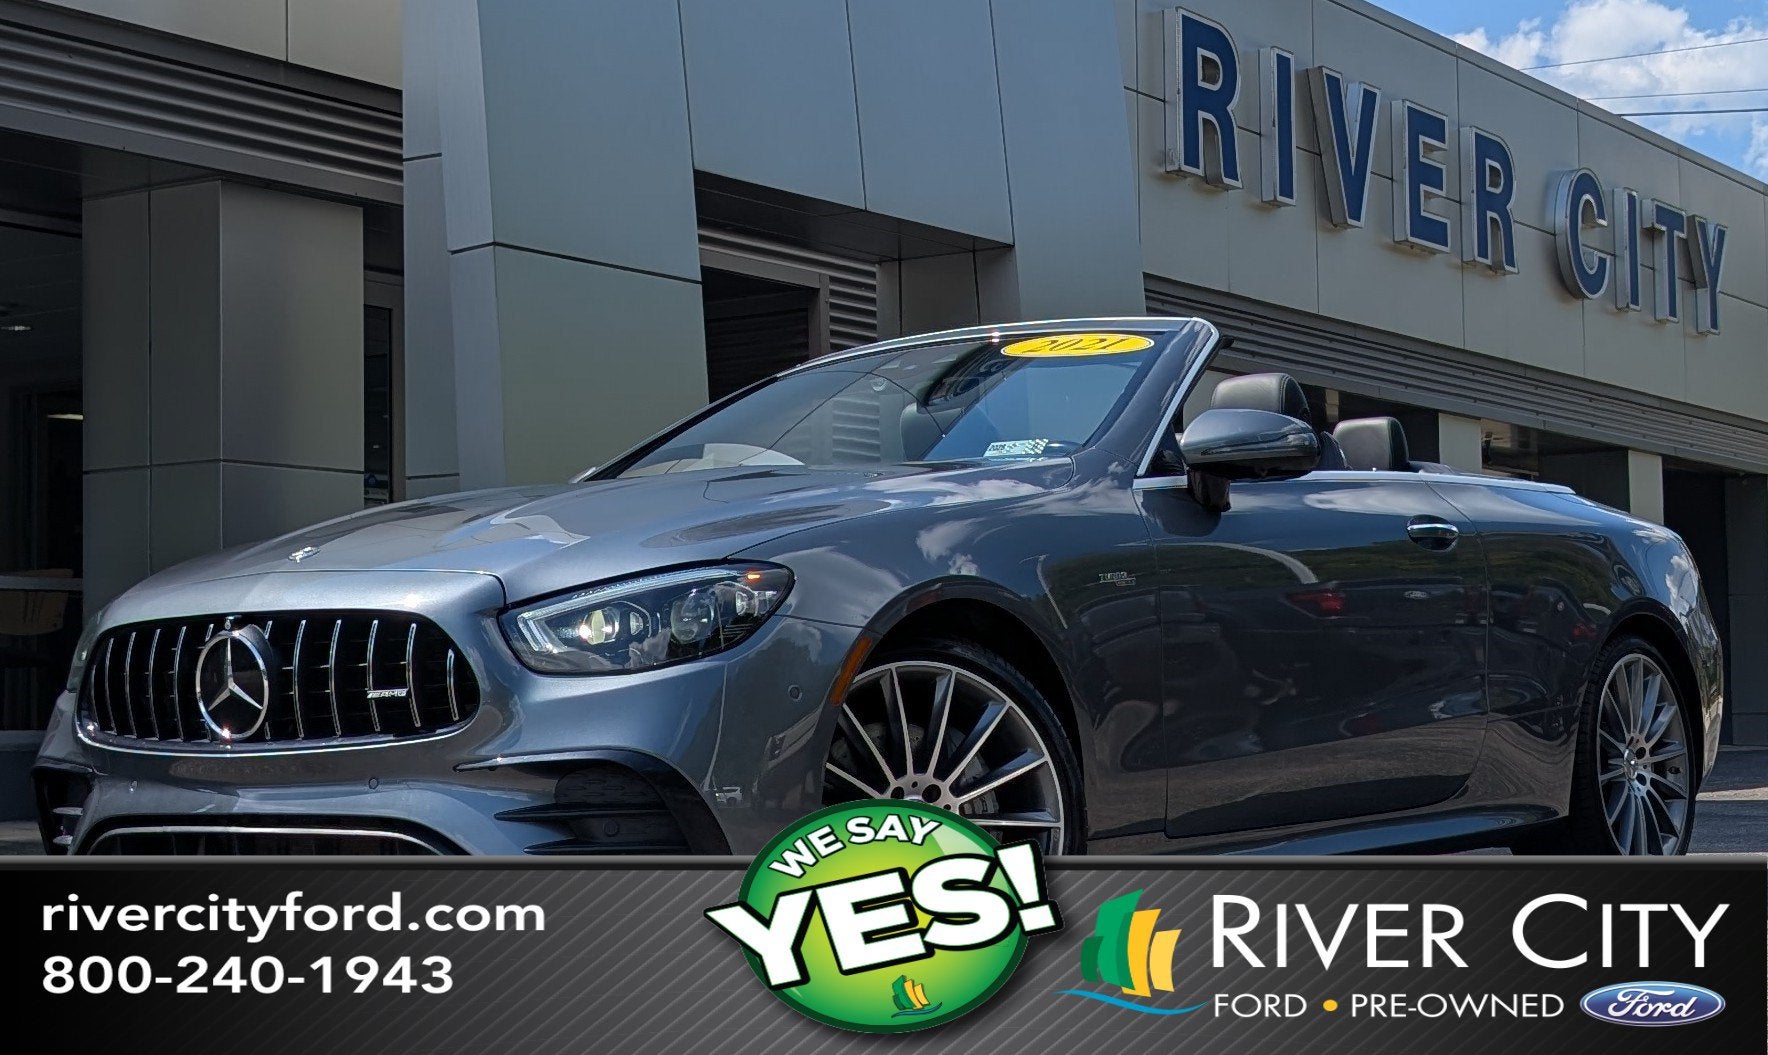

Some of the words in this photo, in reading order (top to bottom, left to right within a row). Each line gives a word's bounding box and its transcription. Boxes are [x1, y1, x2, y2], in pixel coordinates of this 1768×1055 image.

[1163, 7, 1517, 275] RIVER
[1555, 168, 1727, 335] CITY
[1021, 337, 1130, 354] 2021
